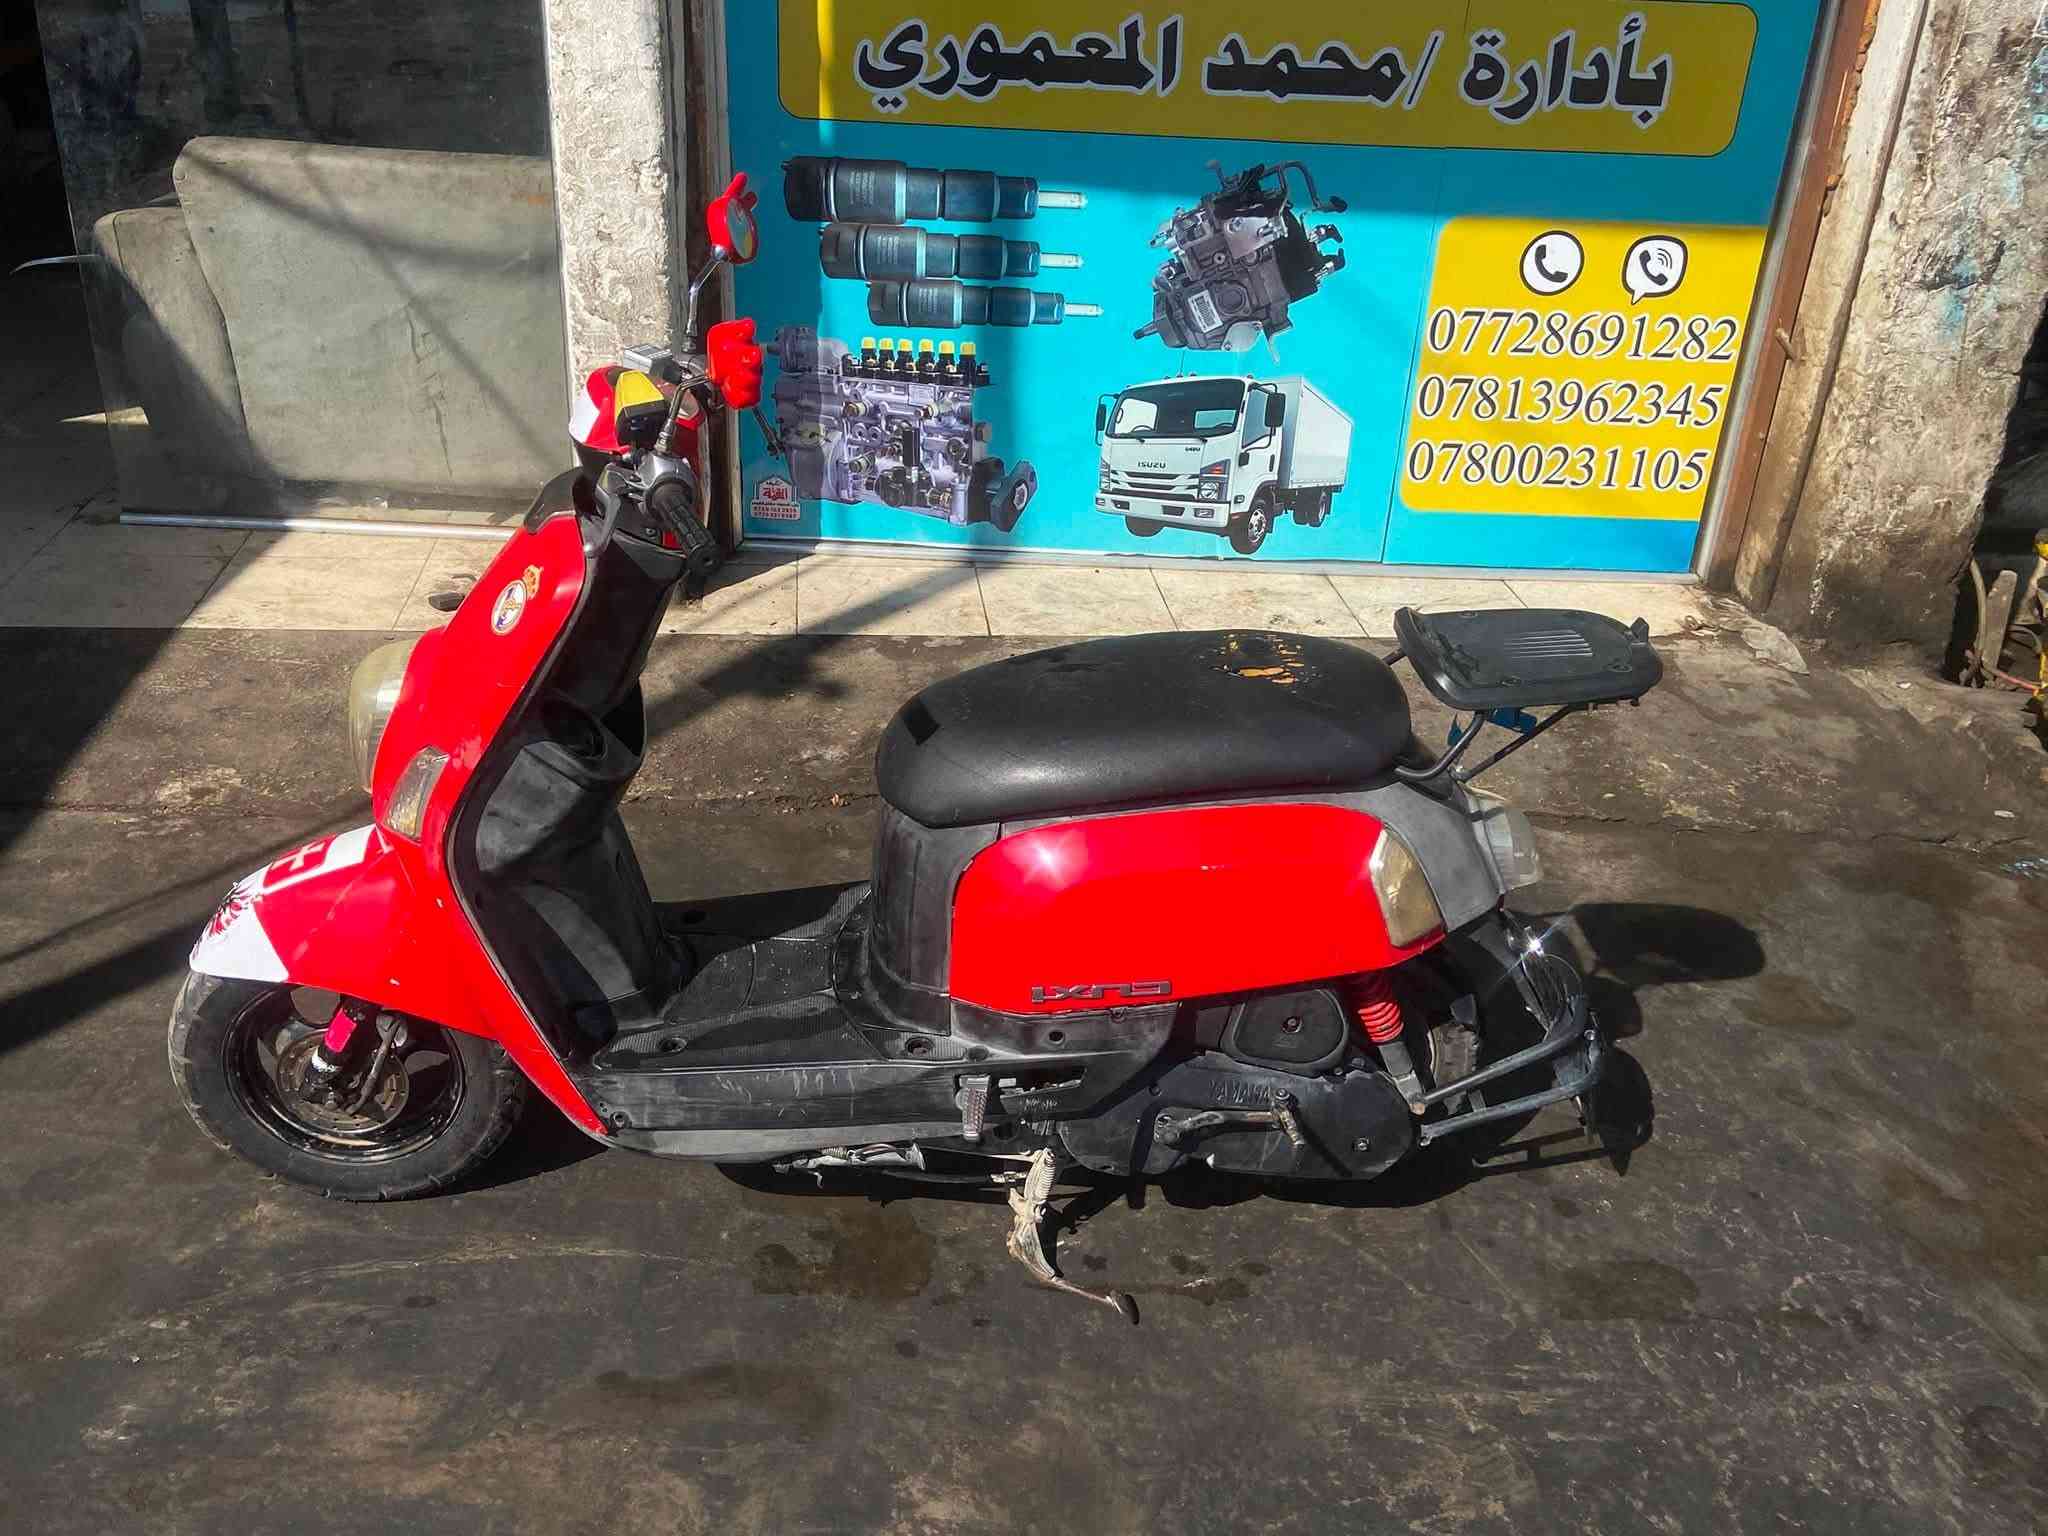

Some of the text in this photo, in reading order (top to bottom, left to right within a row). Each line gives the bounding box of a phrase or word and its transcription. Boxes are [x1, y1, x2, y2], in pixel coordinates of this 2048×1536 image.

[857, 16, 1181, 111] المعموري
[1461, 15, 1670, 127] بأدارة
[1428, 307, 1738, 362] 07728691282
[1418, 375, 1724, 428] 07813962345
[1137, 460, 1167, 469] ISUZU
[1408, 440, 1709, 492] 07800231105
